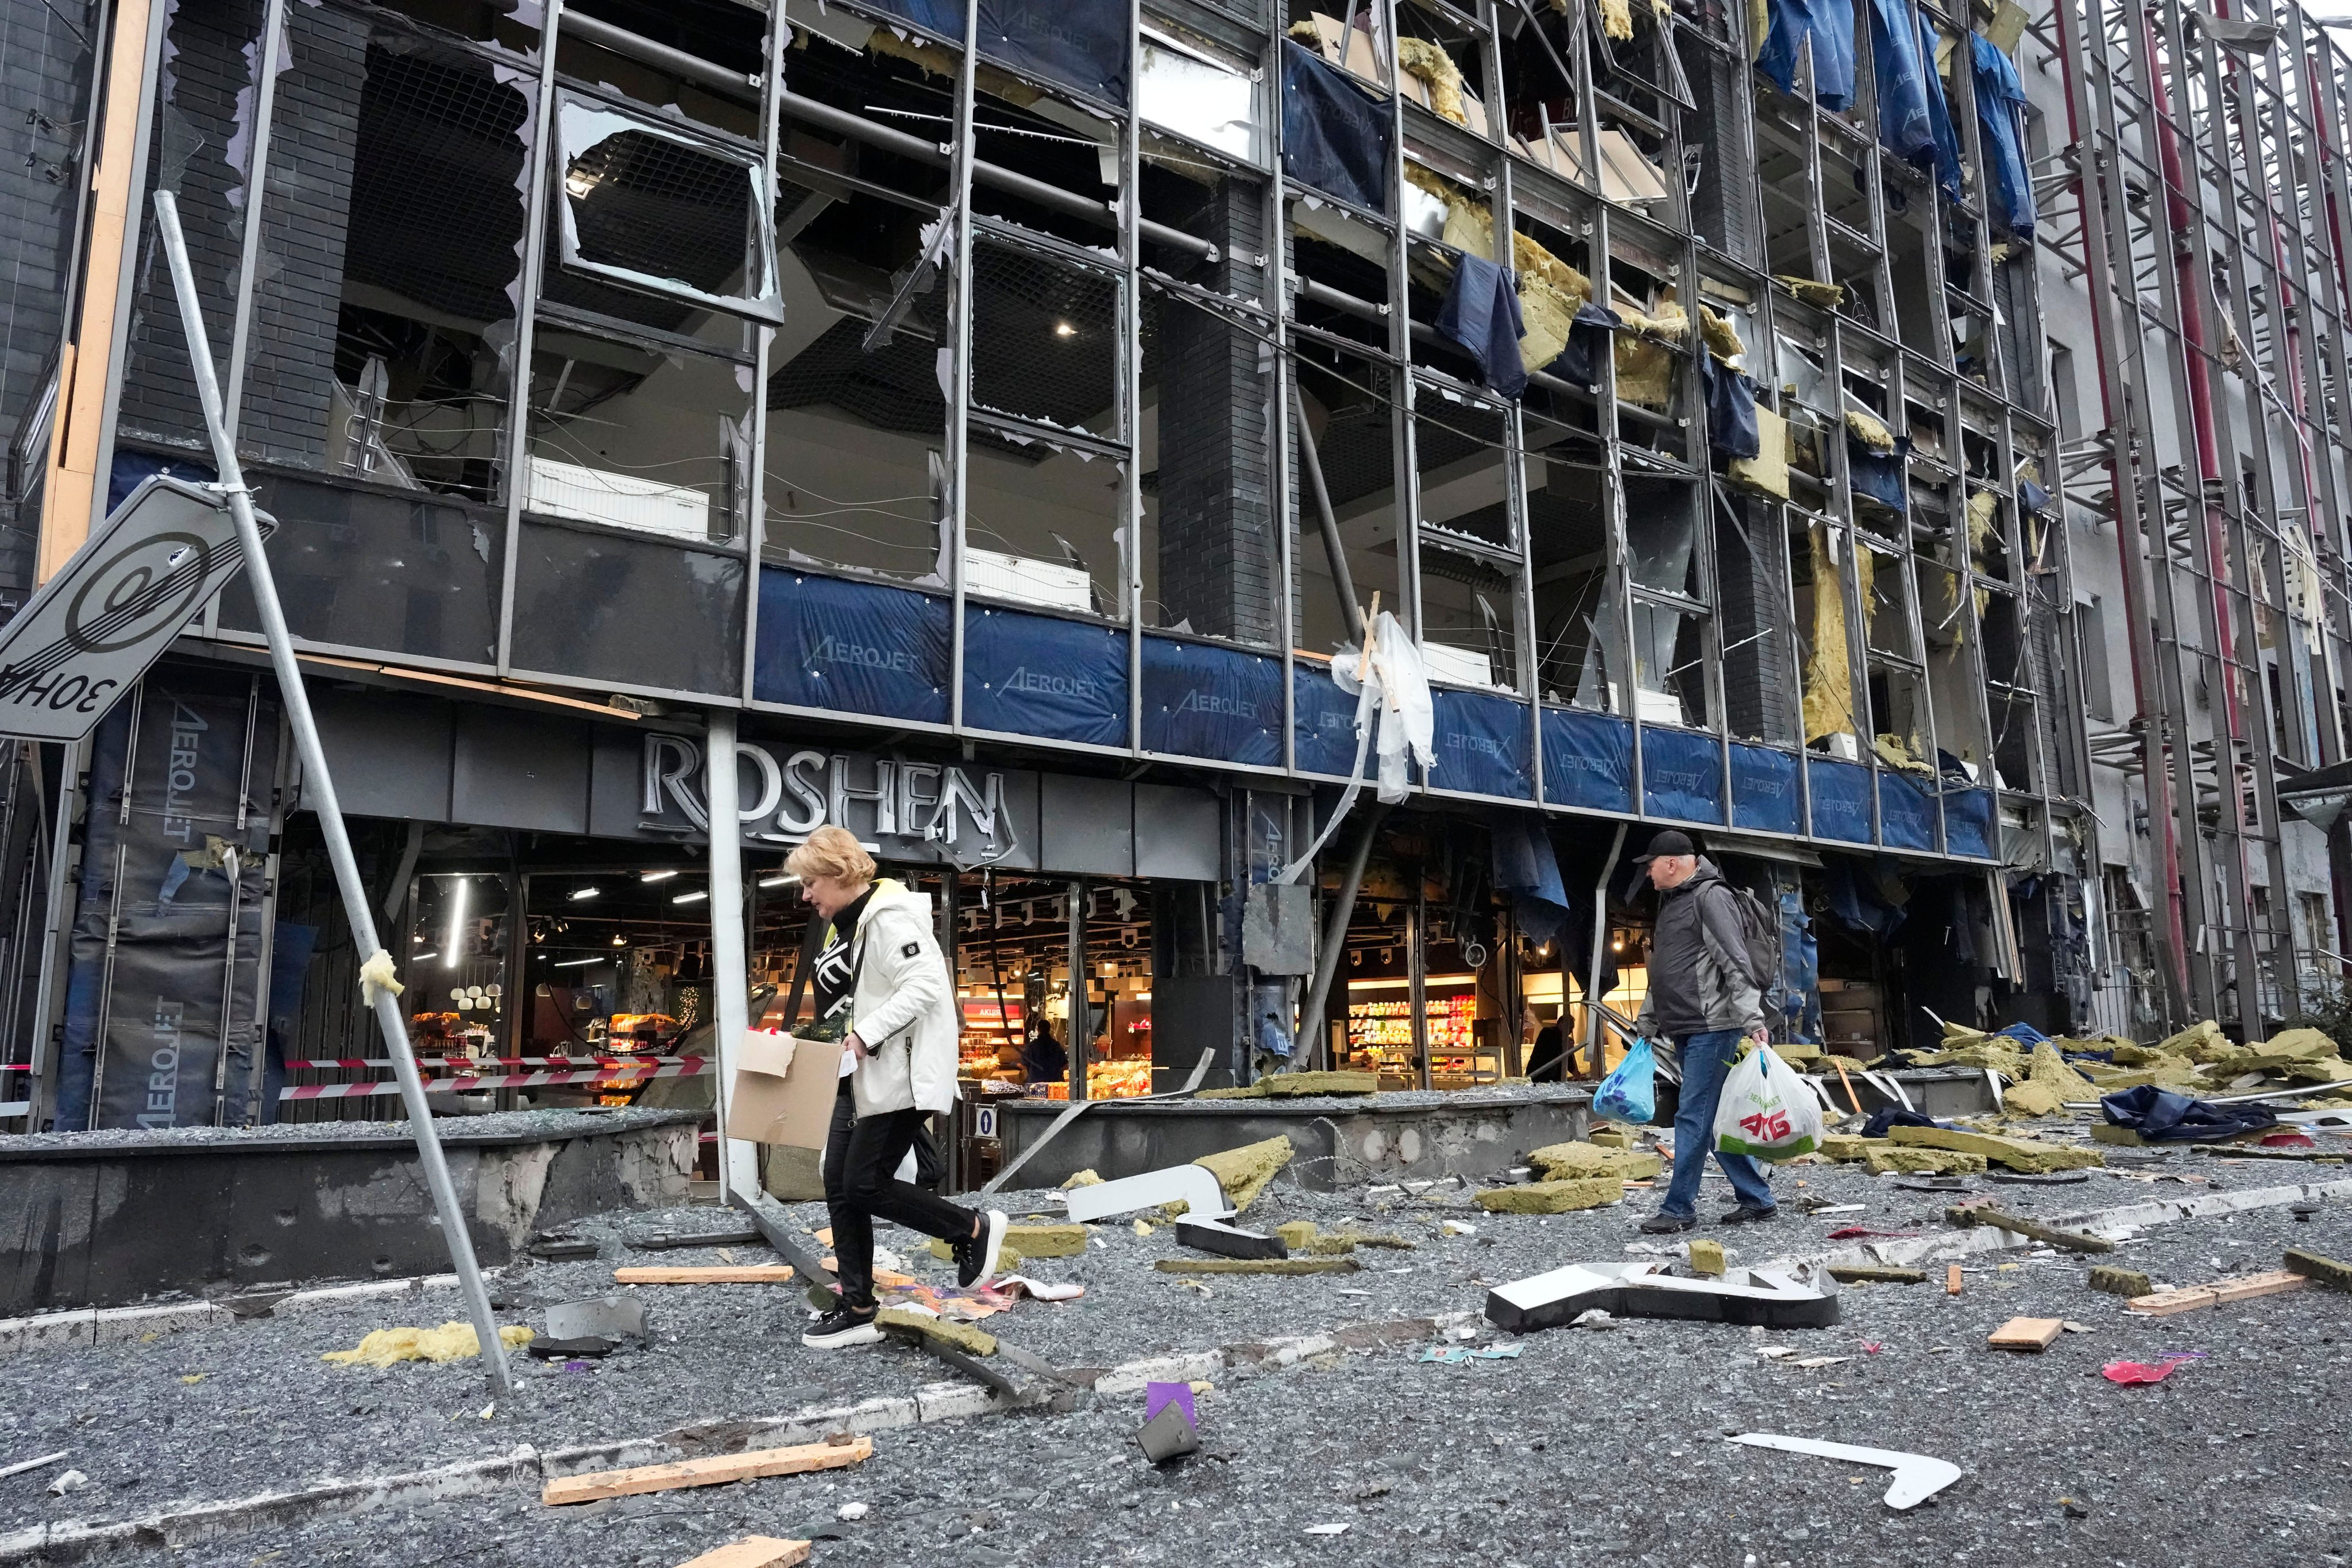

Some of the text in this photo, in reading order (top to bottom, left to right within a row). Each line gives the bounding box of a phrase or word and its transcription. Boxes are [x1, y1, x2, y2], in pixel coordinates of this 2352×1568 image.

[802, 635, 918, 673] AEROJET
[995, 666, 1099, 699] AEROJET
[1172, 689, 1257, 720] AEROJET
[1445, 732, 1511, 759] AEROJET
[160, 686, 208, 843] AEROJET
[1561, 752, 1621, 778] AEROJET
[1654, 767, 1708, 791] AEROJET
[639, 732, 1006, 844] ROSHEN
[1741, 776, 1791, 799] AEROJET
[136, 995, 184, 1129] AEROJET
